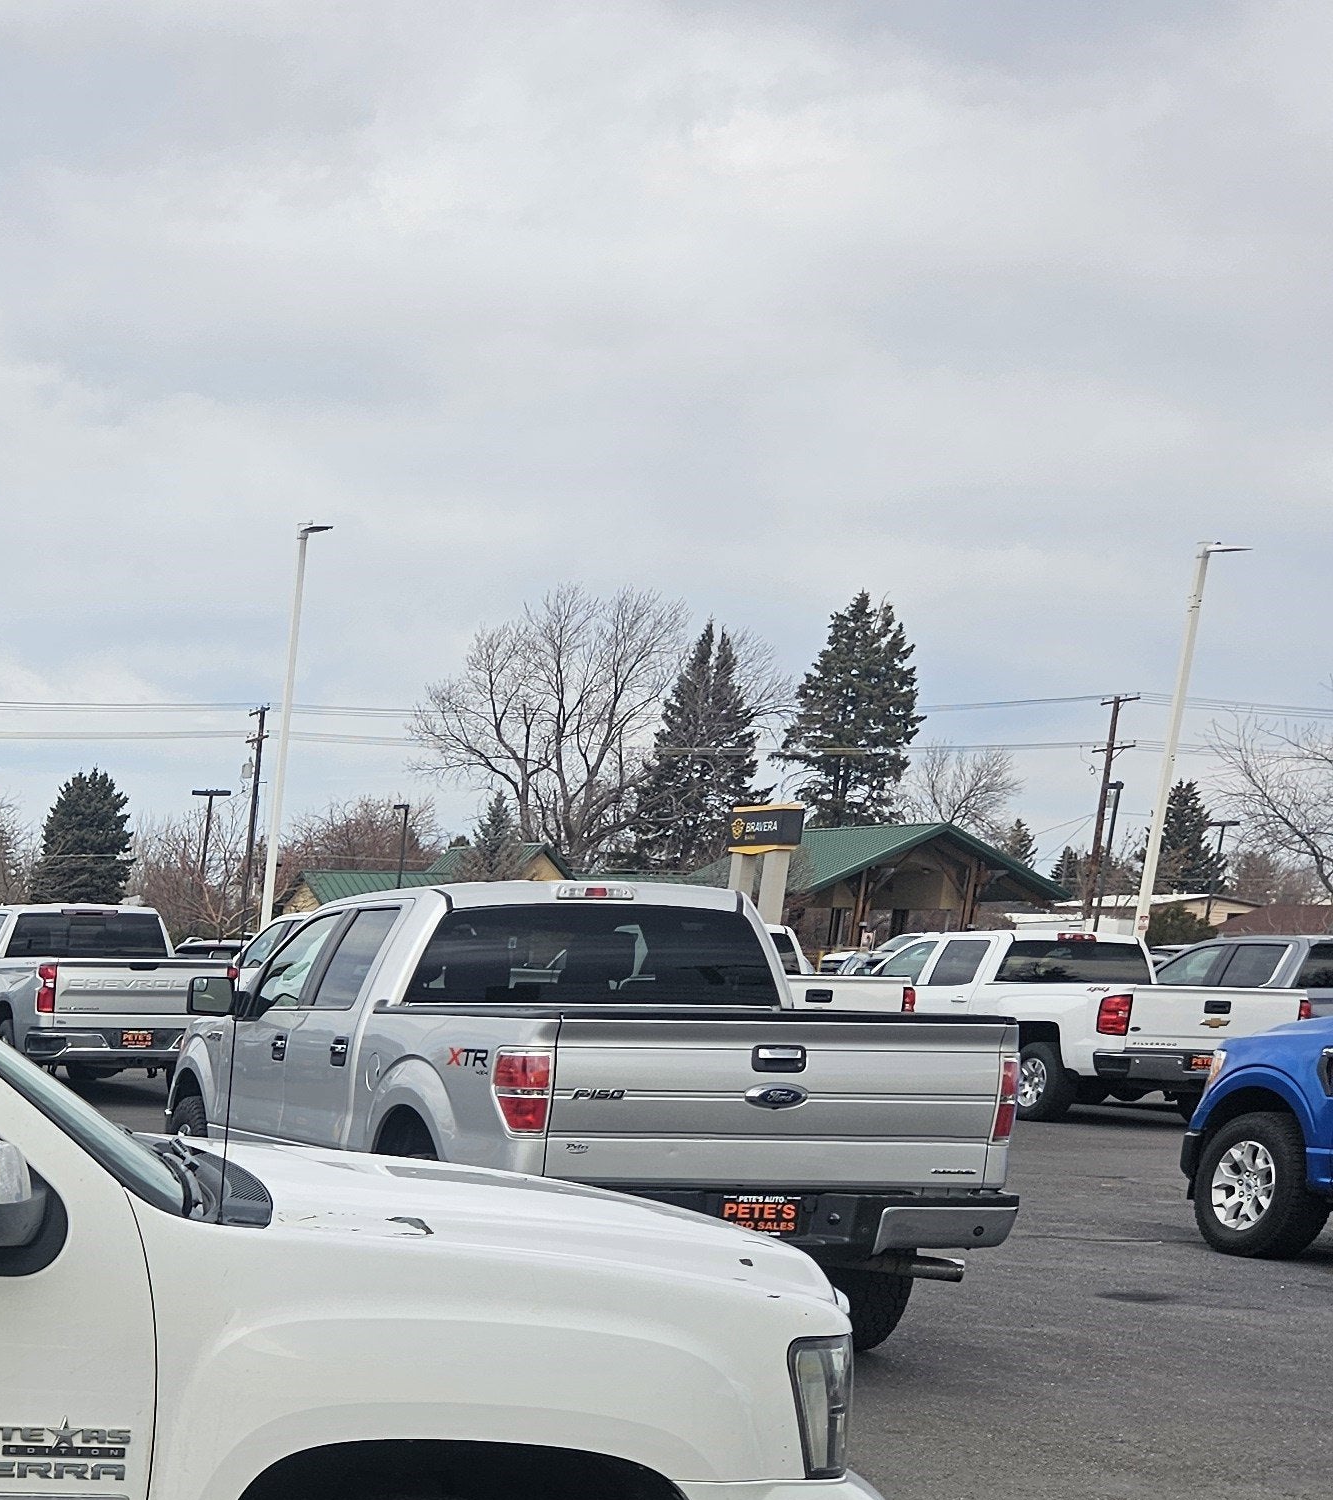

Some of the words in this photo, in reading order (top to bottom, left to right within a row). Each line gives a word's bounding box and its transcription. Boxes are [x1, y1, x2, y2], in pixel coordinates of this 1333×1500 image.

[745, 820, 778, 833] BRAVERA
[122, 1033, 152, 1041] PETE'S
[446, 1047, 488, 1068] XTR
[767, 1090, 793, 1101] Ford
[723, 1203, 796, 1220] PETE'S
[757, 1221, 795, 1231] SALES
[9, 1447, 120, 1456] EDITION
